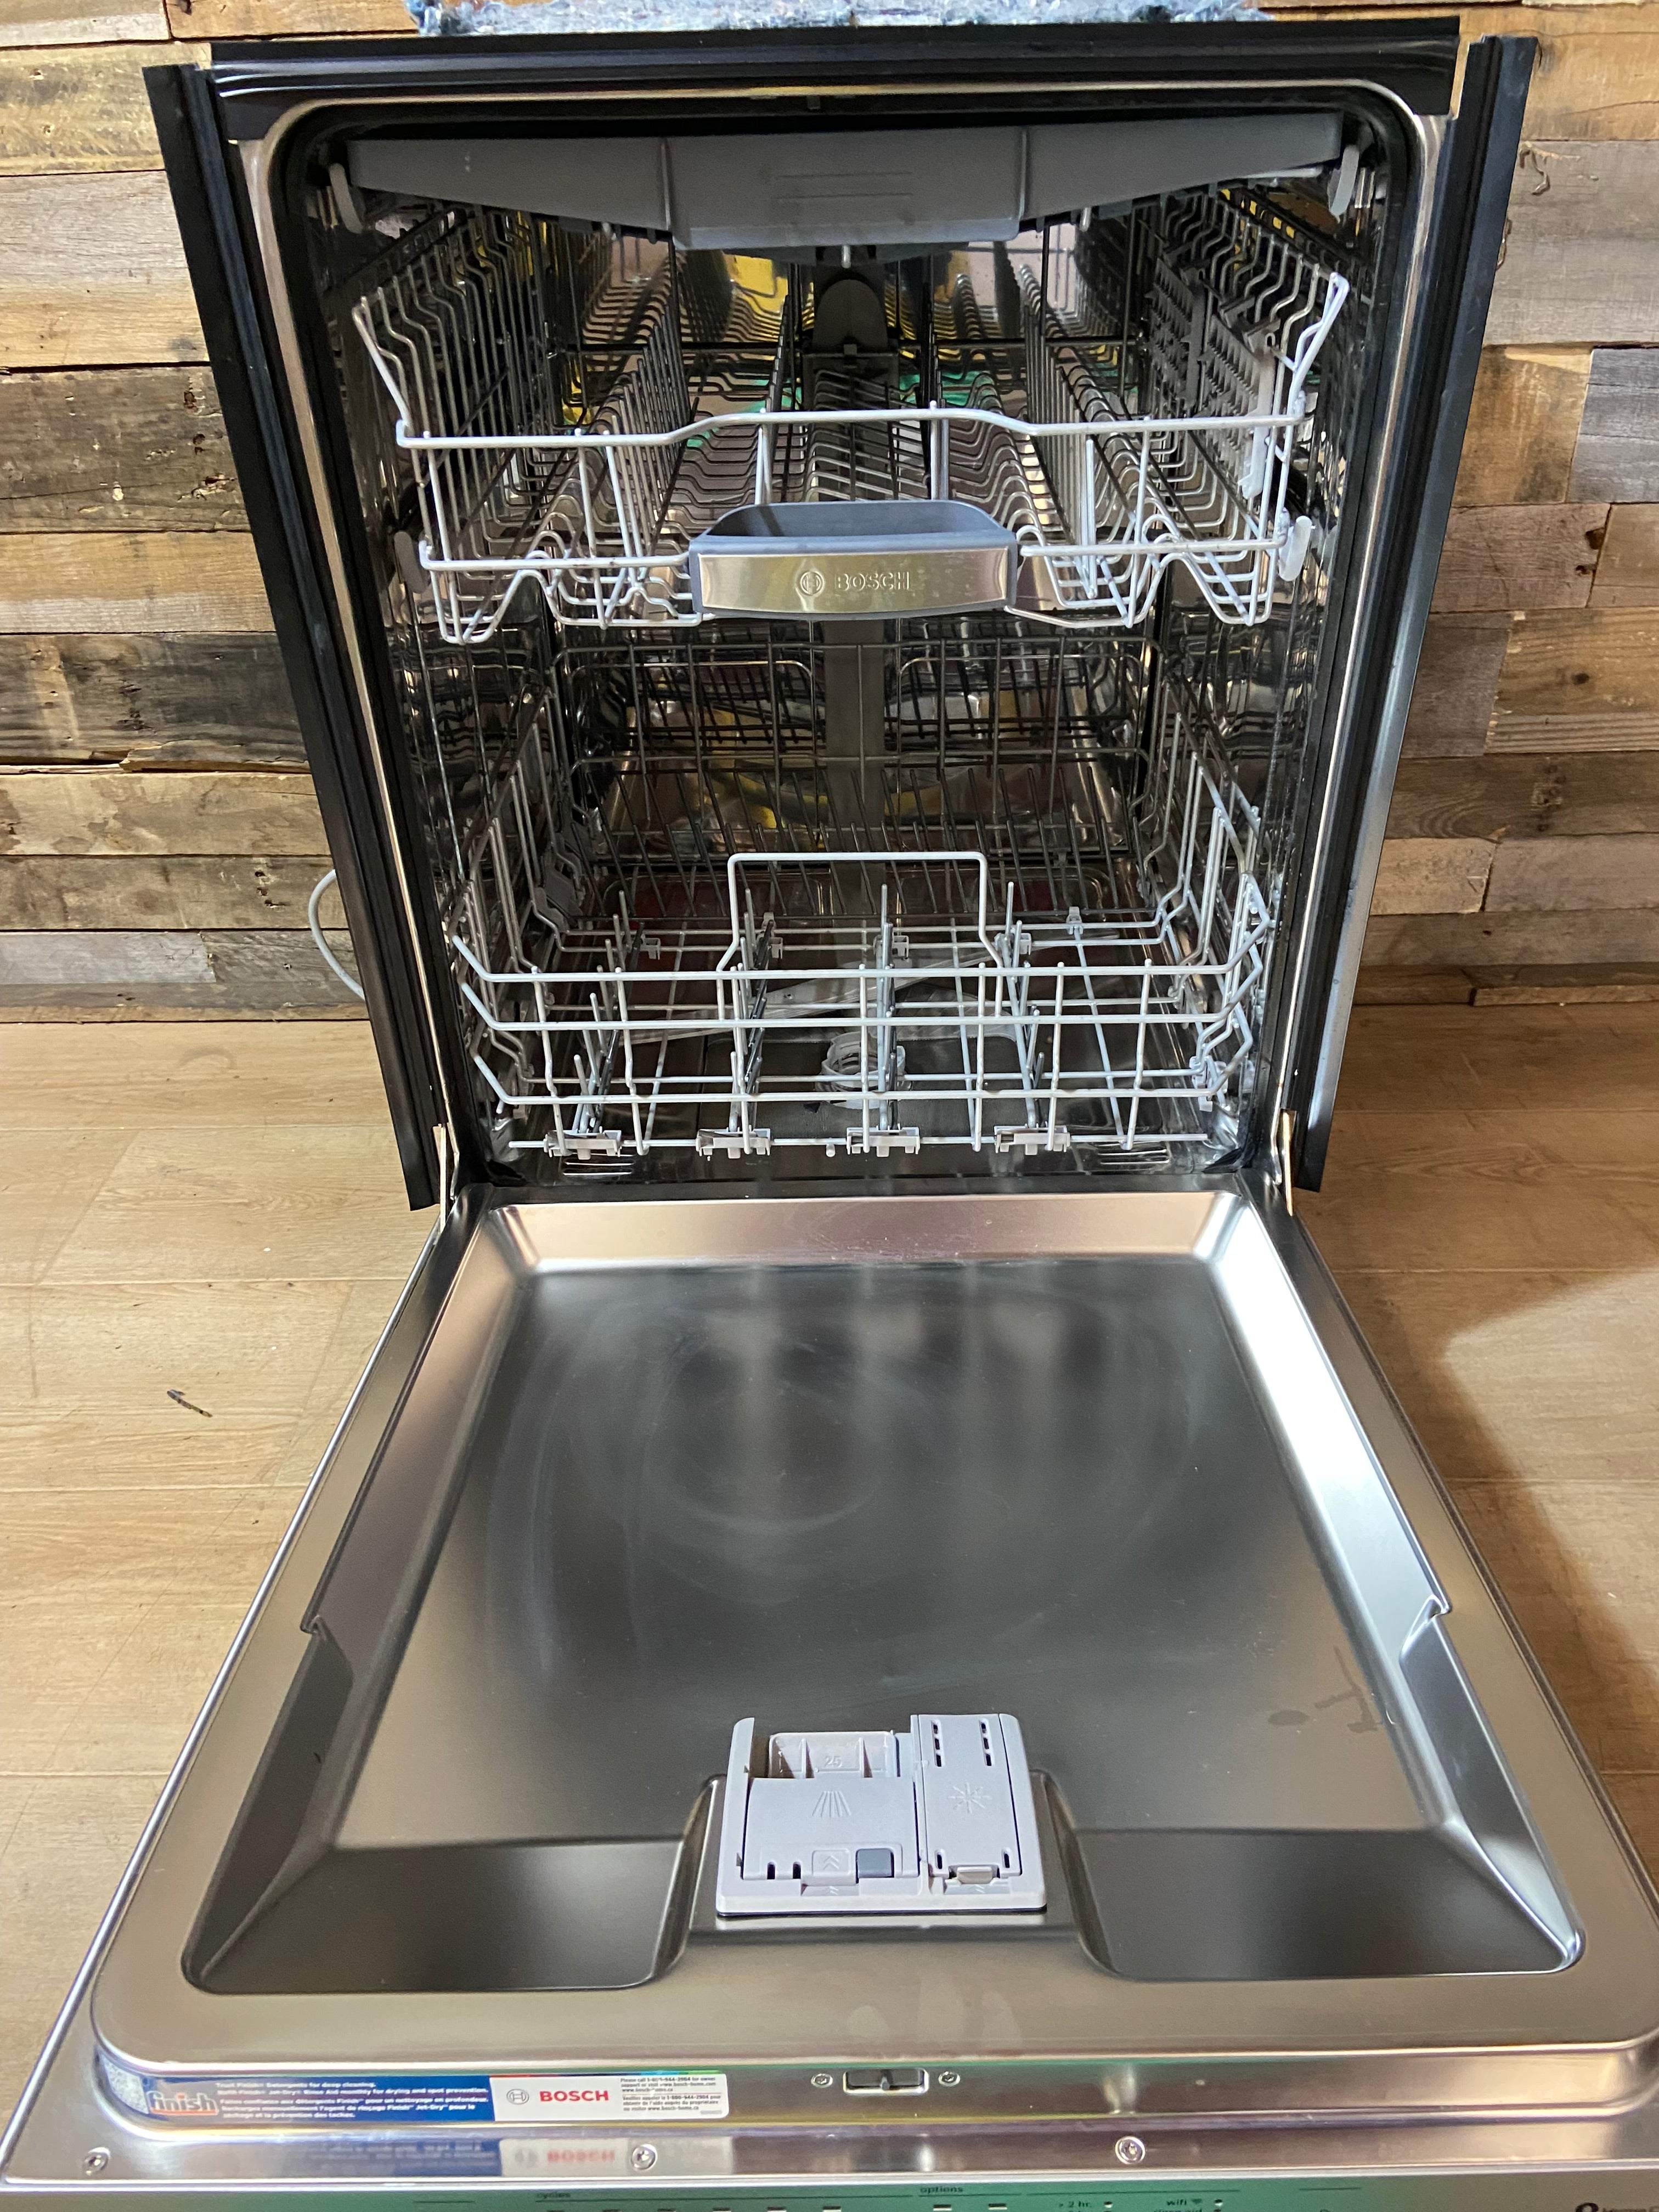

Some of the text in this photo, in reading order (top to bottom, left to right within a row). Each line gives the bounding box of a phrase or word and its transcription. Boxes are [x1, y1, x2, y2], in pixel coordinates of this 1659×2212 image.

[834, 571, 910, 592] BOSCH
[146, 2091, 219, 2114] finish
[539, 2090, 609, 2102] BOSCH
